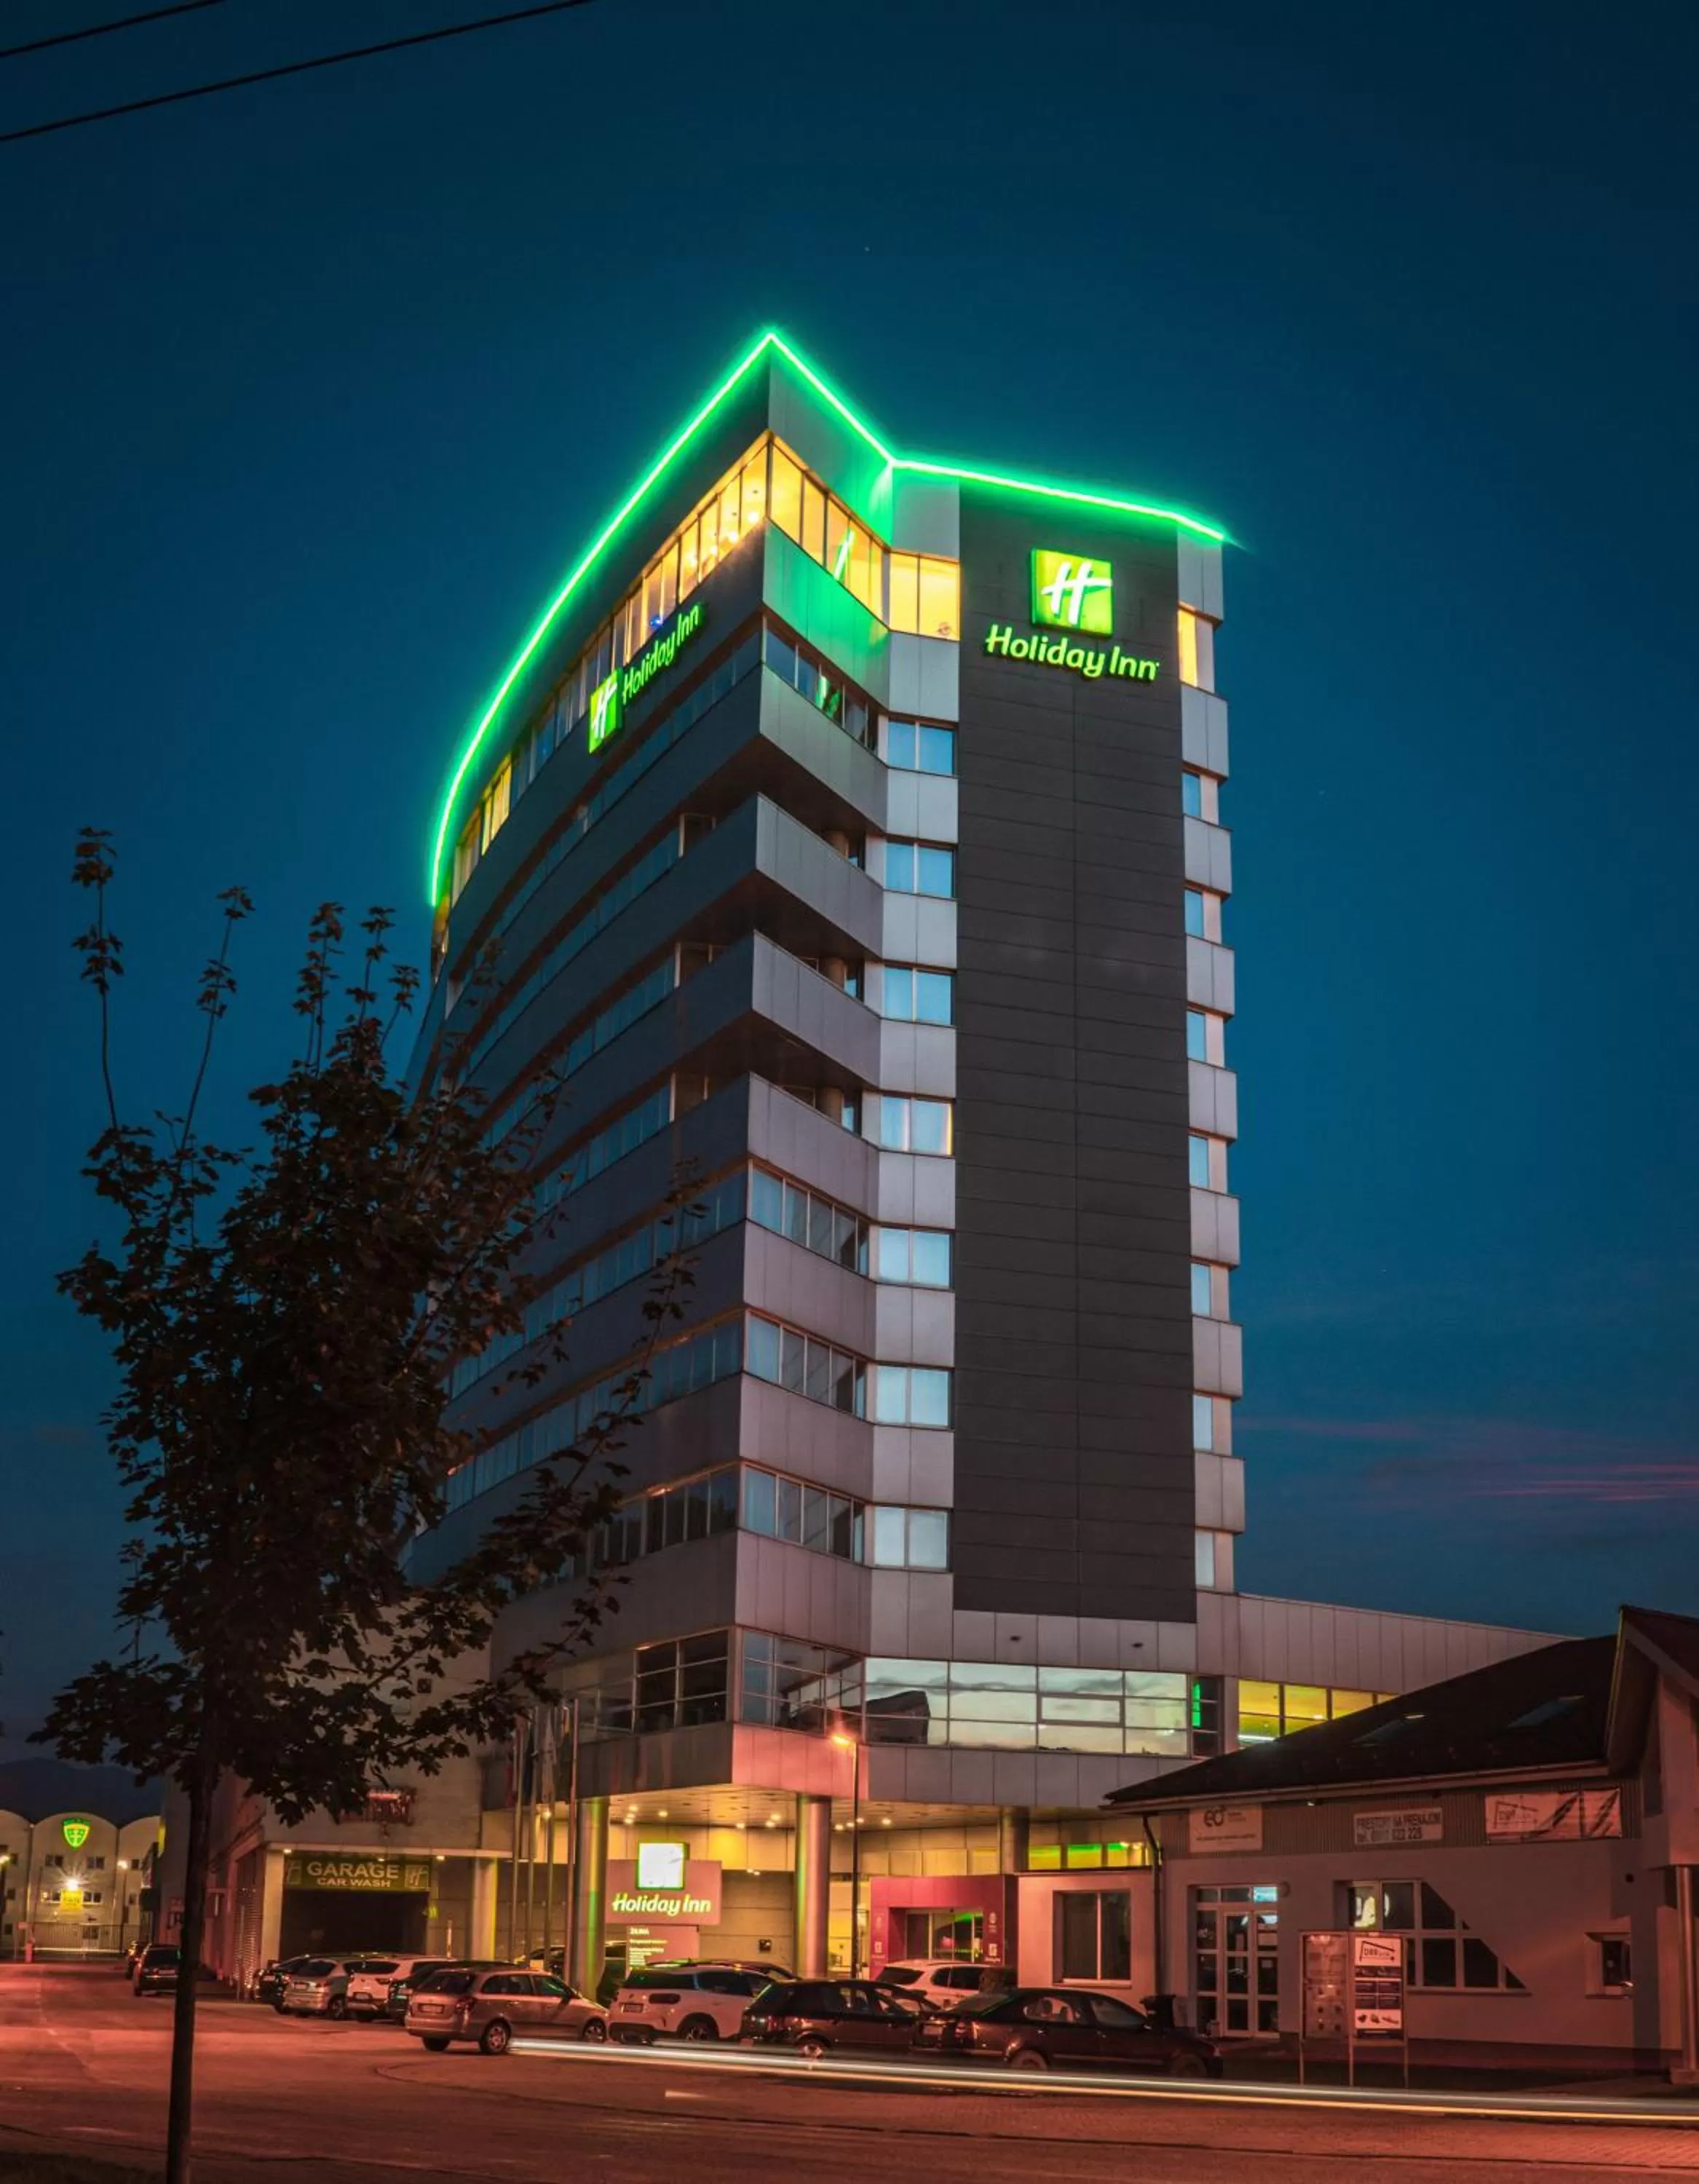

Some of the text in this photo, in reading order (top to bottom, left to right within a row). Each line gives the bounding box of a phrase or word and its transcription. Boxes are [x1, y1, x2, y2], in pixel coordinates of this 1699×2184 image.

[622, 605, 700, 705] Holiday Inn
[985, 624, 1157, 681] Holiday Inn
[306, 1861, 400, 1879] GARAGE
[317, 1877, 391, 1888] CAR WASH
[612, 1893, 711, 1917] Holiday Inn
